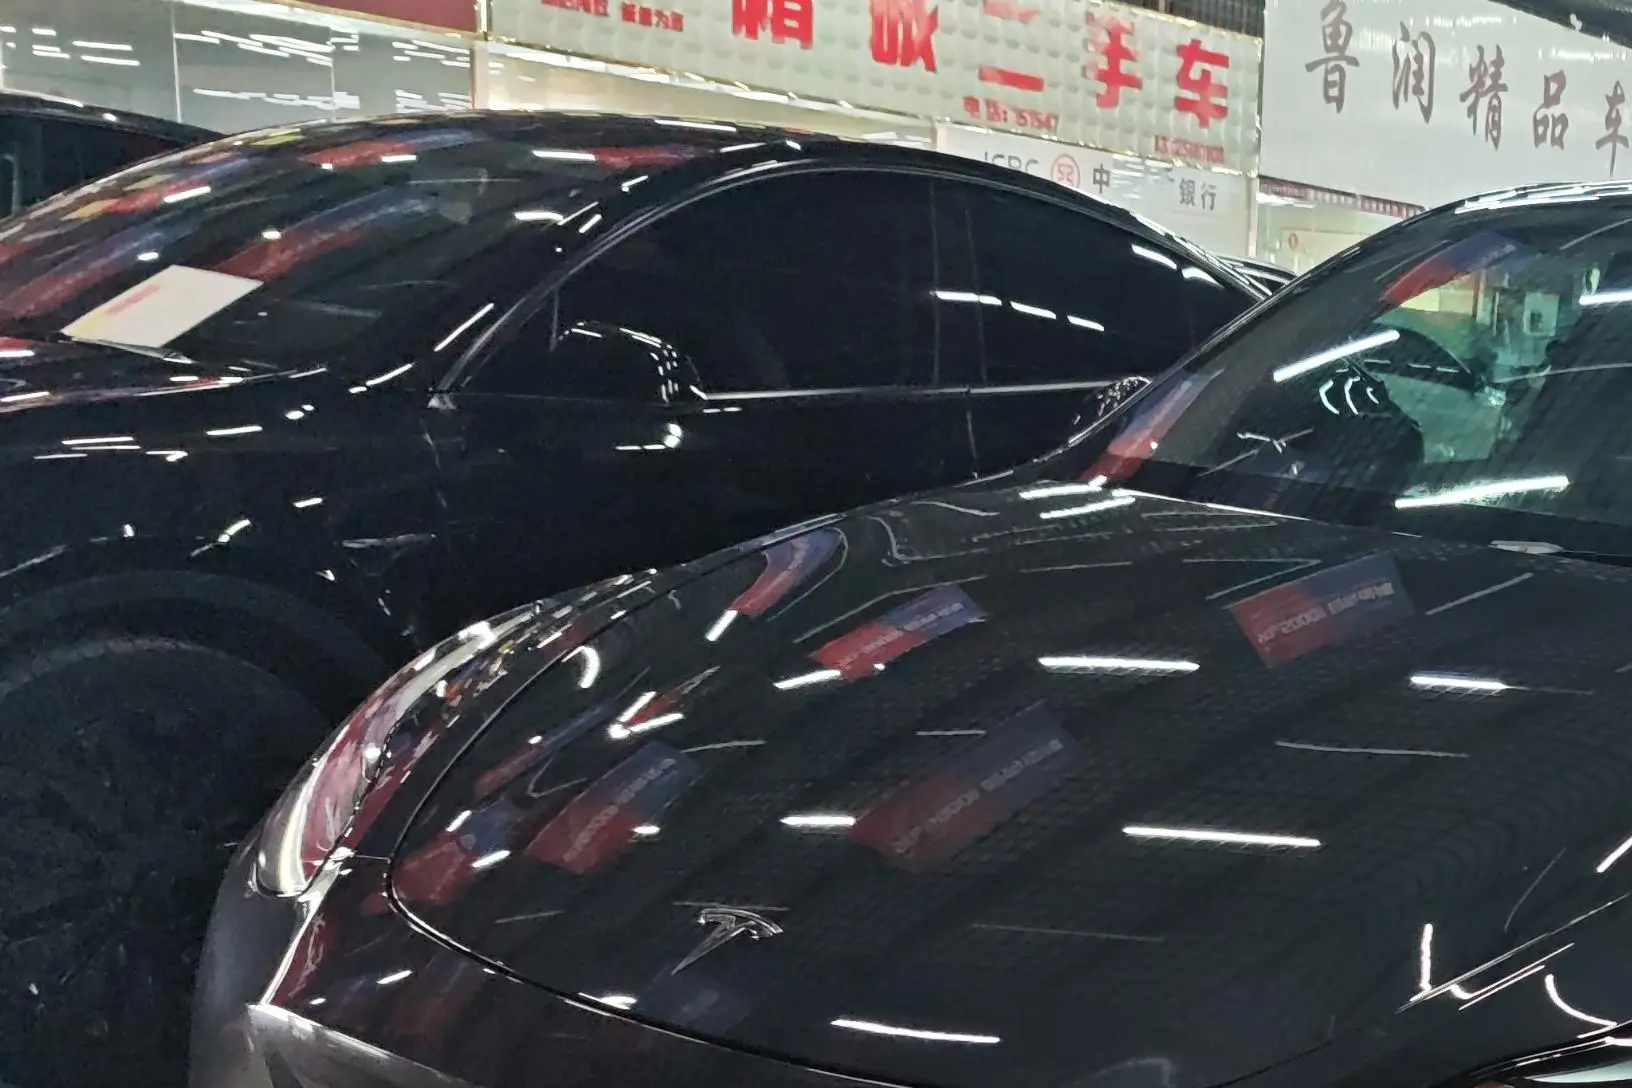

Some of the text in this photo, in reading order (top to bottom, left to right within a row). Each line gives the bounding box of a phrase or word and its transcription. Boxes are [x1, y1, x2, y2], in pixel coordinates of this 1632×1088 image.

[1305, 0, 1629, 177] 鲁润精品车
